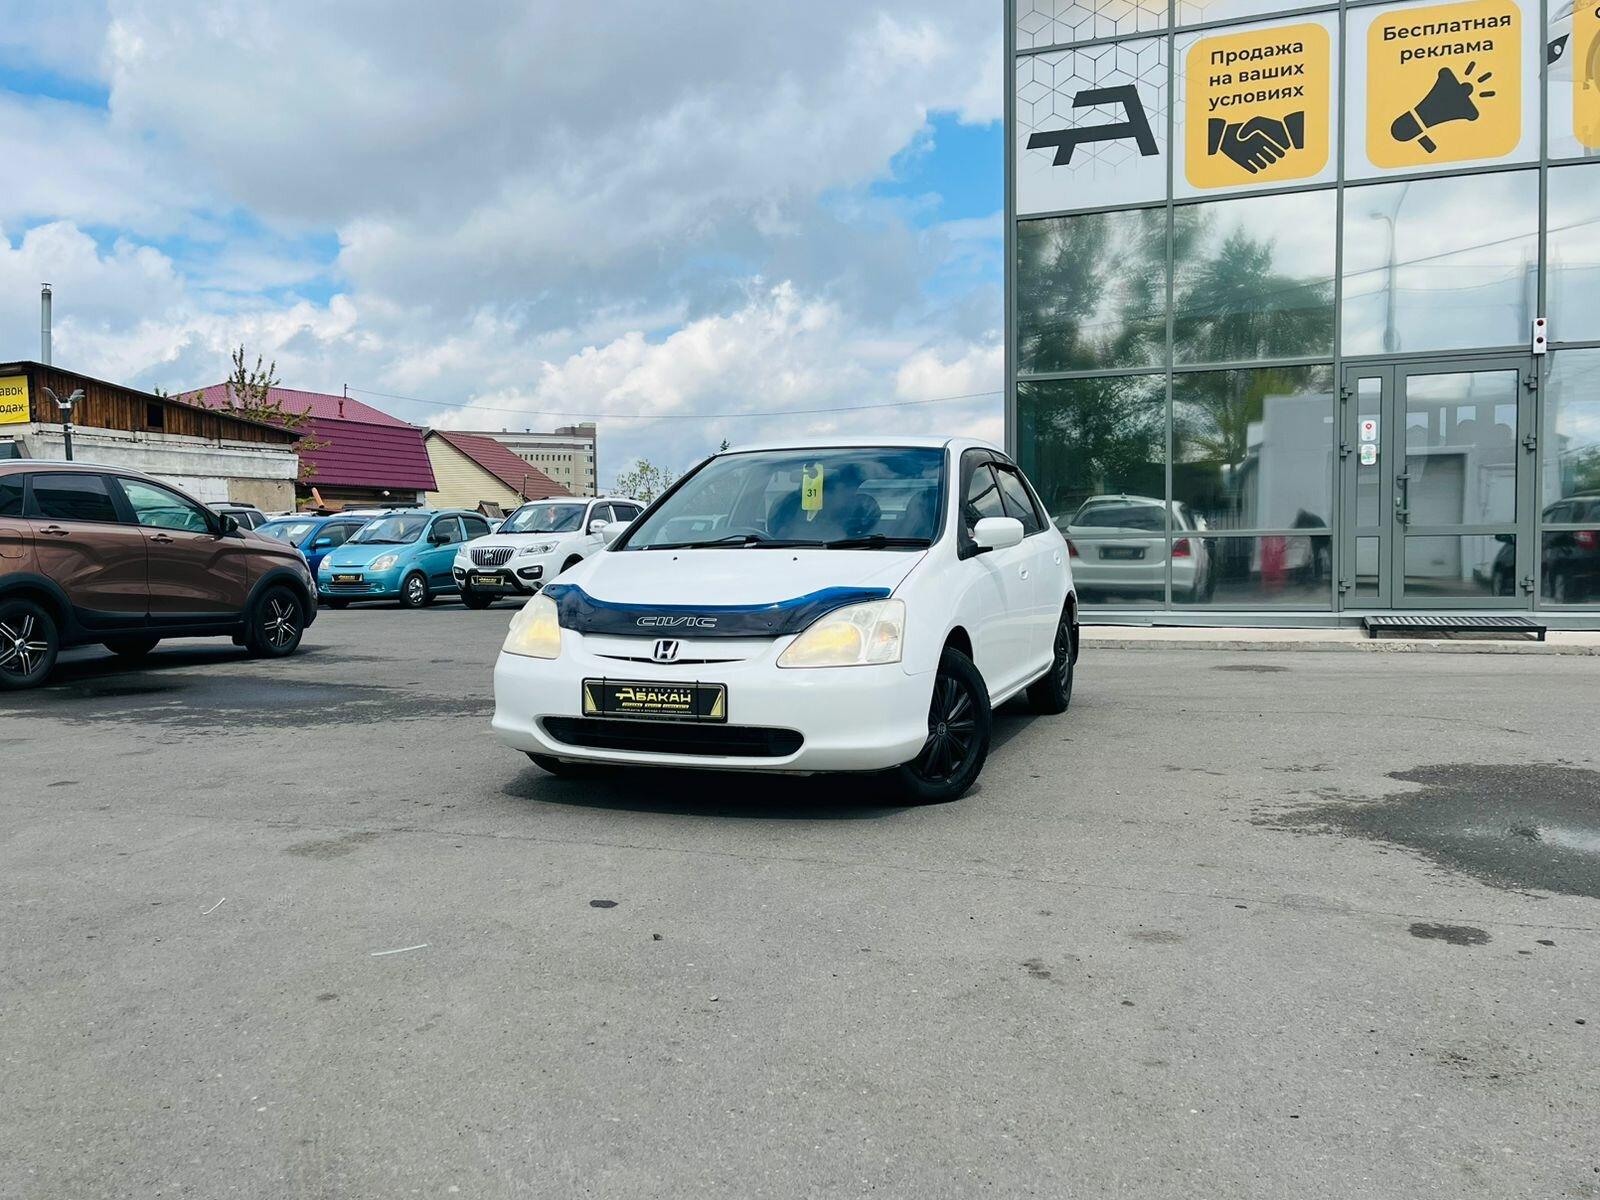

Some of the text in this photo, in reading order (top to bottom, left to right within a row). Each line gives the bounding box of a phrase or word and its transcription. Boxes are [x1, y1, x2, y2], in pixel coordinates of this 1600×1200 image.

[1383, 14, 1511, 41] Бесплатная
[1211, 42, 1304, 66] Продажа
[1400, 39, 1494, 64] реклама
[1209, 63, 1304, 87] на ваших
[1208, 85, 1305, 112] условиях
[806, 488, 817, 498] 31
[636, 616, 718, 628] CIVIC
